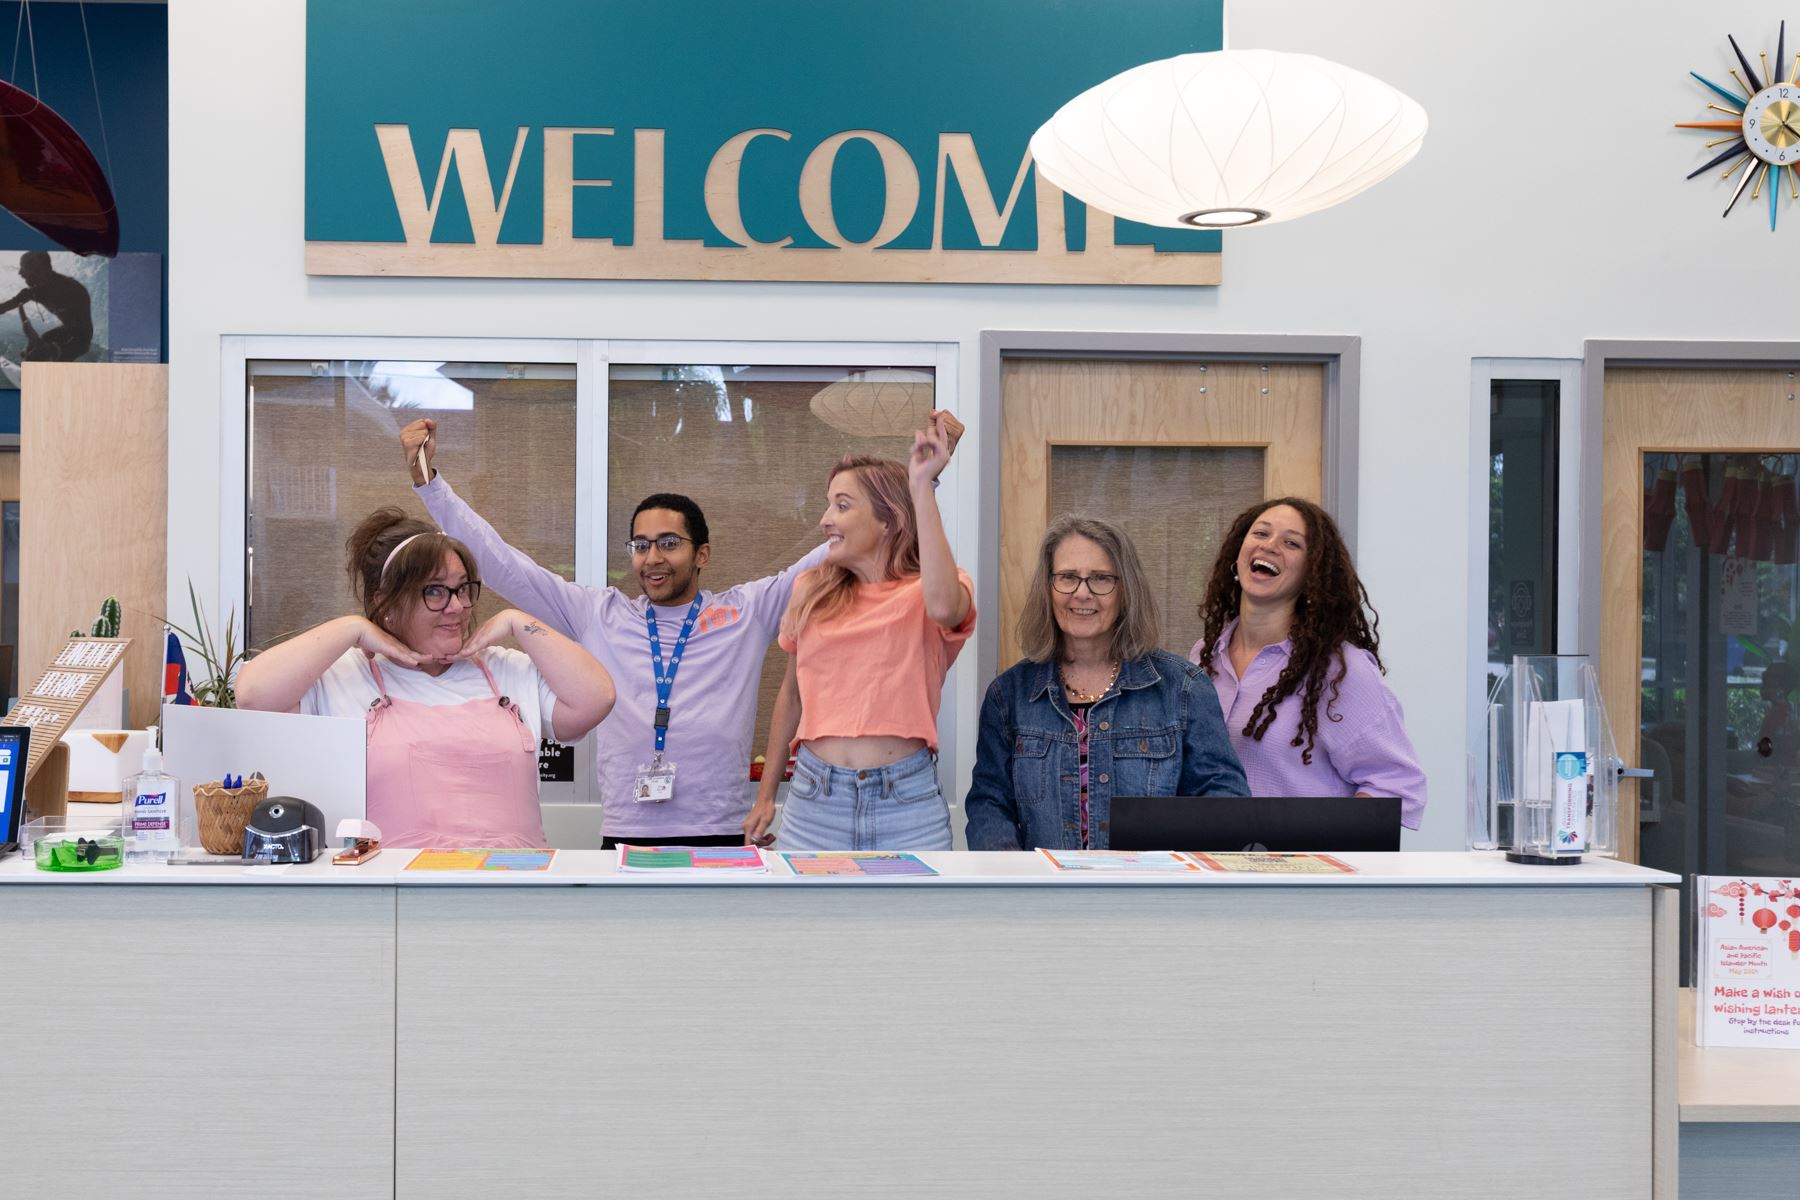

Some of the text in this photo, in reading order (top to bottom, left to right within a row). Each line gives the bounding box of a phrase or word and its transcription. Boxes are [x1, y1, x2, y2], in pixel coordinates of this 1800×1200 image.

[1779, 88, 1789, 99] 12
[1749, 118, 1755, 129] 9
[1779, 150, 1785, 162] 6
[138, 795, 163, 805] Purell
[1714, 986, 1748, 998] Make
[1751, 989, 1759, 998] a
[1763, 987, 1791, 999] wish
[1713, 1002, 1760, 1016] wishing
[1728, 1017, 1746, 1026] Stop
[1747, 1017, 1757, 1026] by
[1759, 1018, 1771, 1026] the
[1773, 1018, 1791, 1026] desk
[1743, 1027, 1789, 1036] instructions
